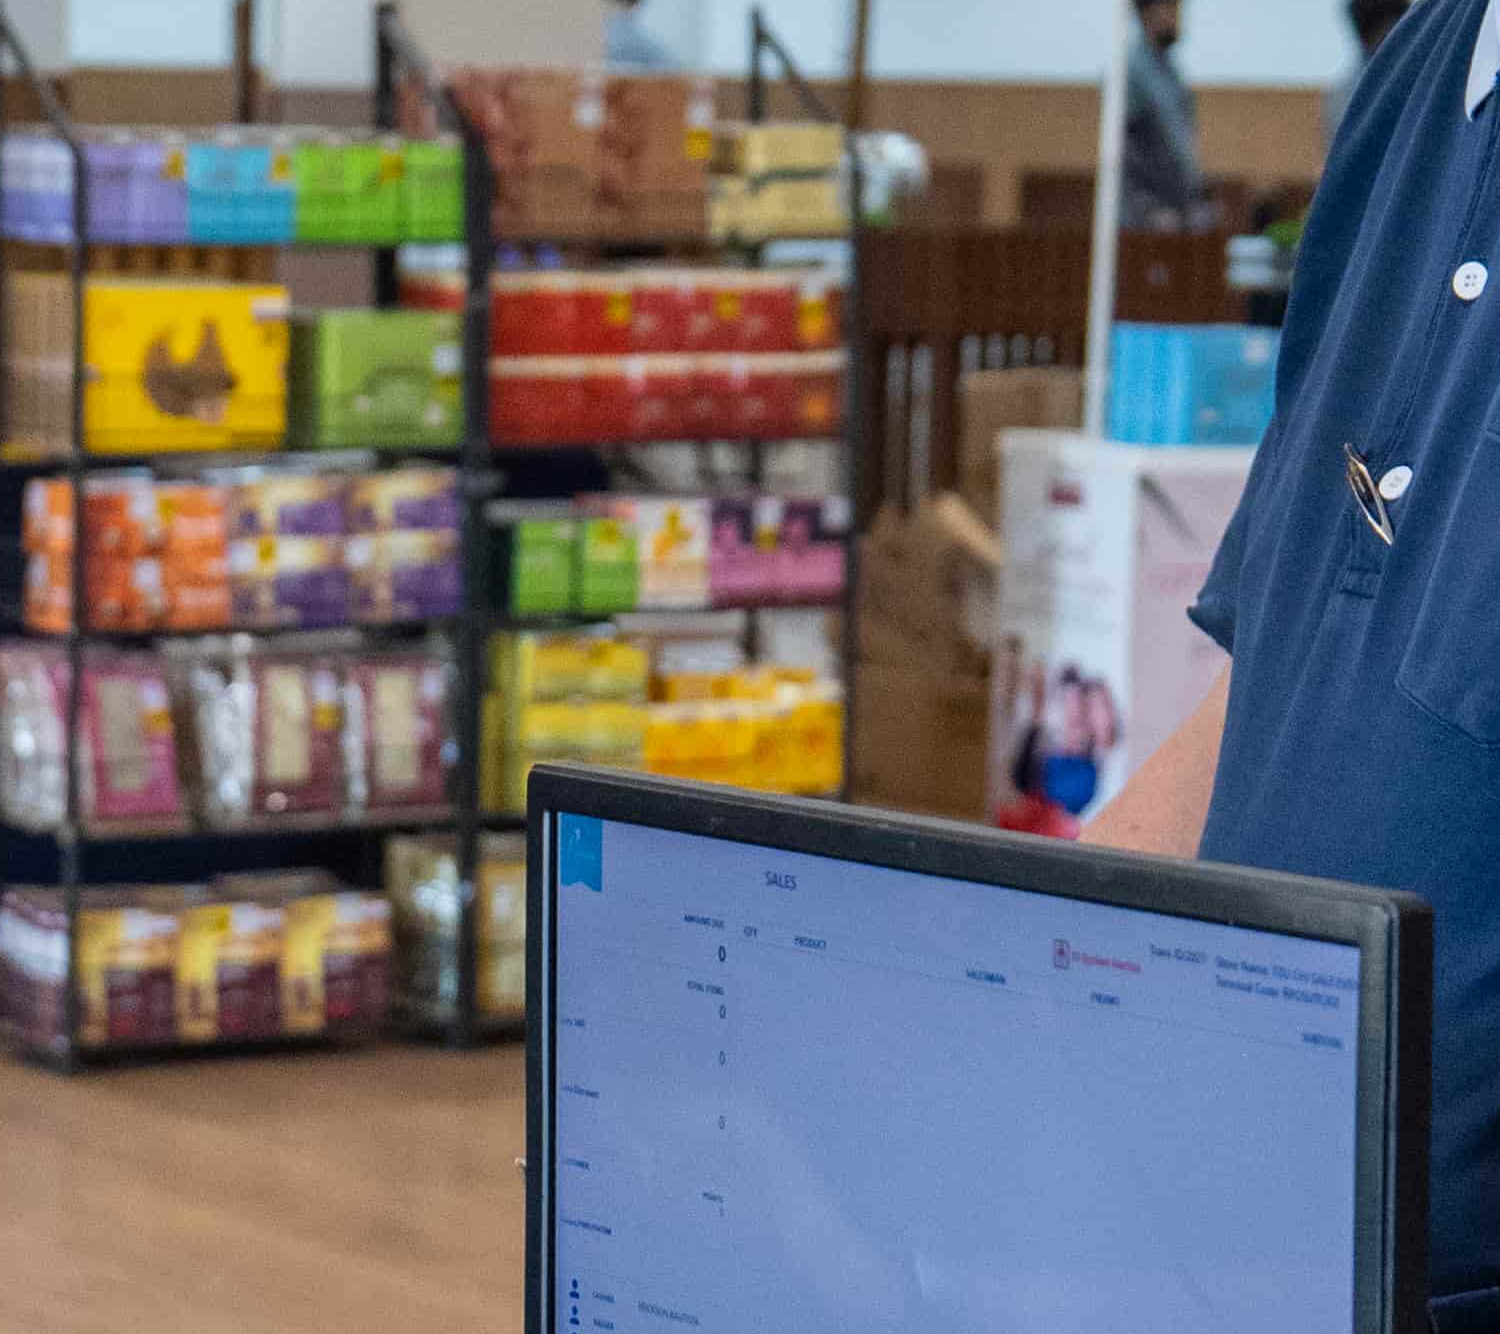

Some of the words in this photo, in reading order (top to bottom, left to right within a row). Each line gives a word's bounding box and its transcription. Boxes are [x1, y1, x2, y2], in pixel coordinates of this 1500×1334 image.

[765, 871, 797, 891] SALES
[718, 945, 727, 962] 0
[718, 1005, 727, 1019] 0
[718, 1051, 727, 1066] 0
